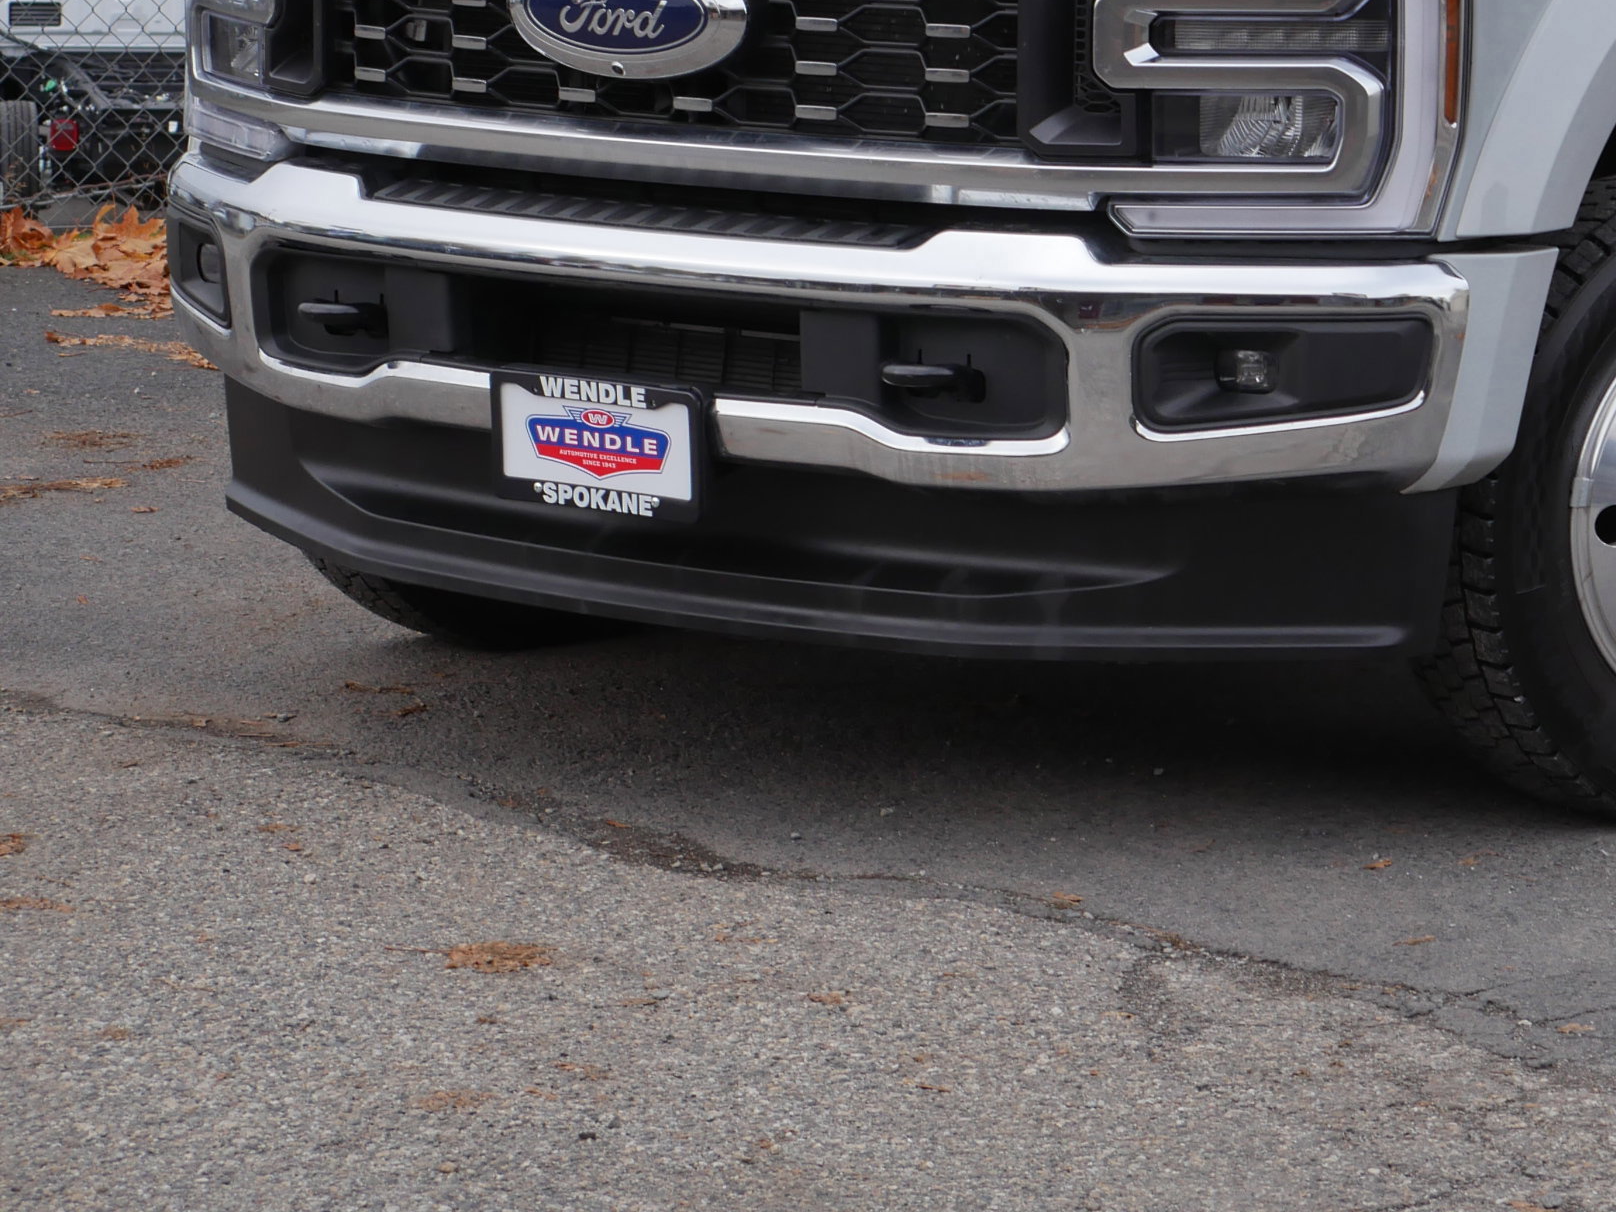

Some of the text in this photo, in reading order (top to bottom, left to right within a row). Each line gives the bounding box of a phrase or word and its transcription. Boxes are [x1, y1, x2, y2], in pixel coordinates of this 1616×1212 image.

[540, 376, 647, 408] WENDLE
[536, 425, 658, 455] WENDLE
[559, 449, 637, 465] AUTOMOTIVE EXCELLENCE
[582, 459, 601, 467] SINCE
[542, 482, 654, 517] SPOKANE
